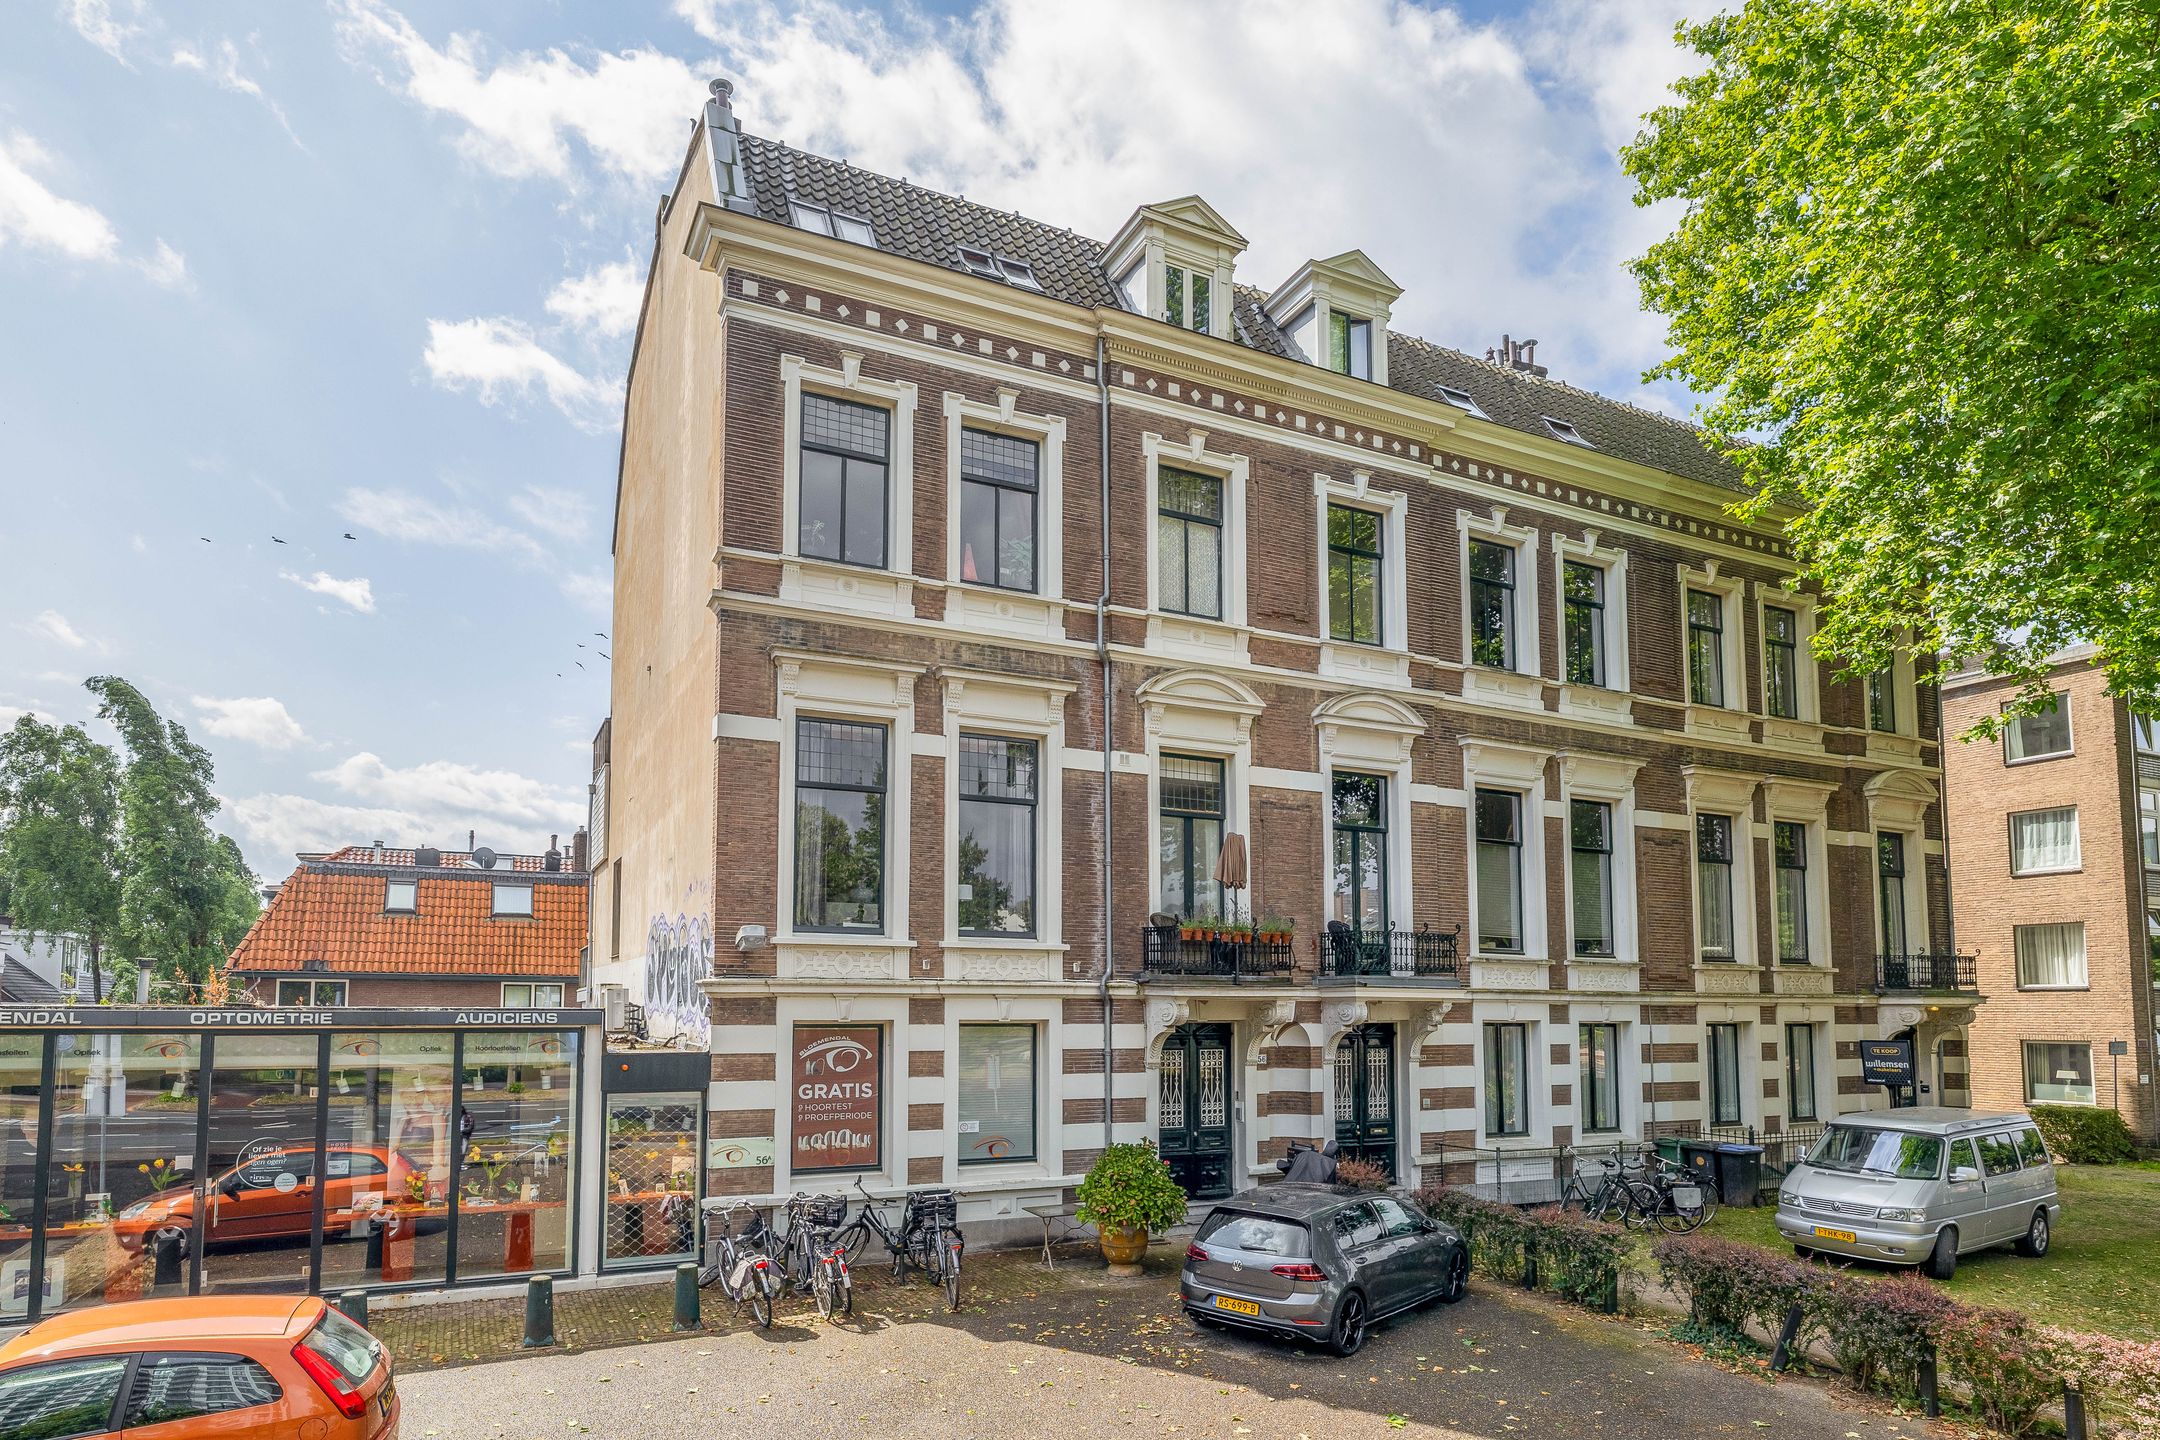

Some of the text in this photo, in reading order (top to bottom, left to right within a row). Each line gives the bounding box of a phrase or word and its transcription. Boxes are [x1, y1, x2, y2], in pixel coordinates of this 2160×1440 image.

[190, 1012, 333, 1025] OPTOMETRIE
[455, 1012, 558, 1024] AUDICIENS
[798, 1035, 851, 1057] BLOEMENDAL
[1866, 1060, 1909, 1068] willemsen
[798, 1083, 873, 1099] GRATIS
[804, 1102, 853, 1111] HOORTEST
[805, 1112, 872, 1121] PROEFPERIODE
[1818, 1228, 1852, 1240] 1-THK-98
[1218, 1297, 1256, 1313] RS-699-B
